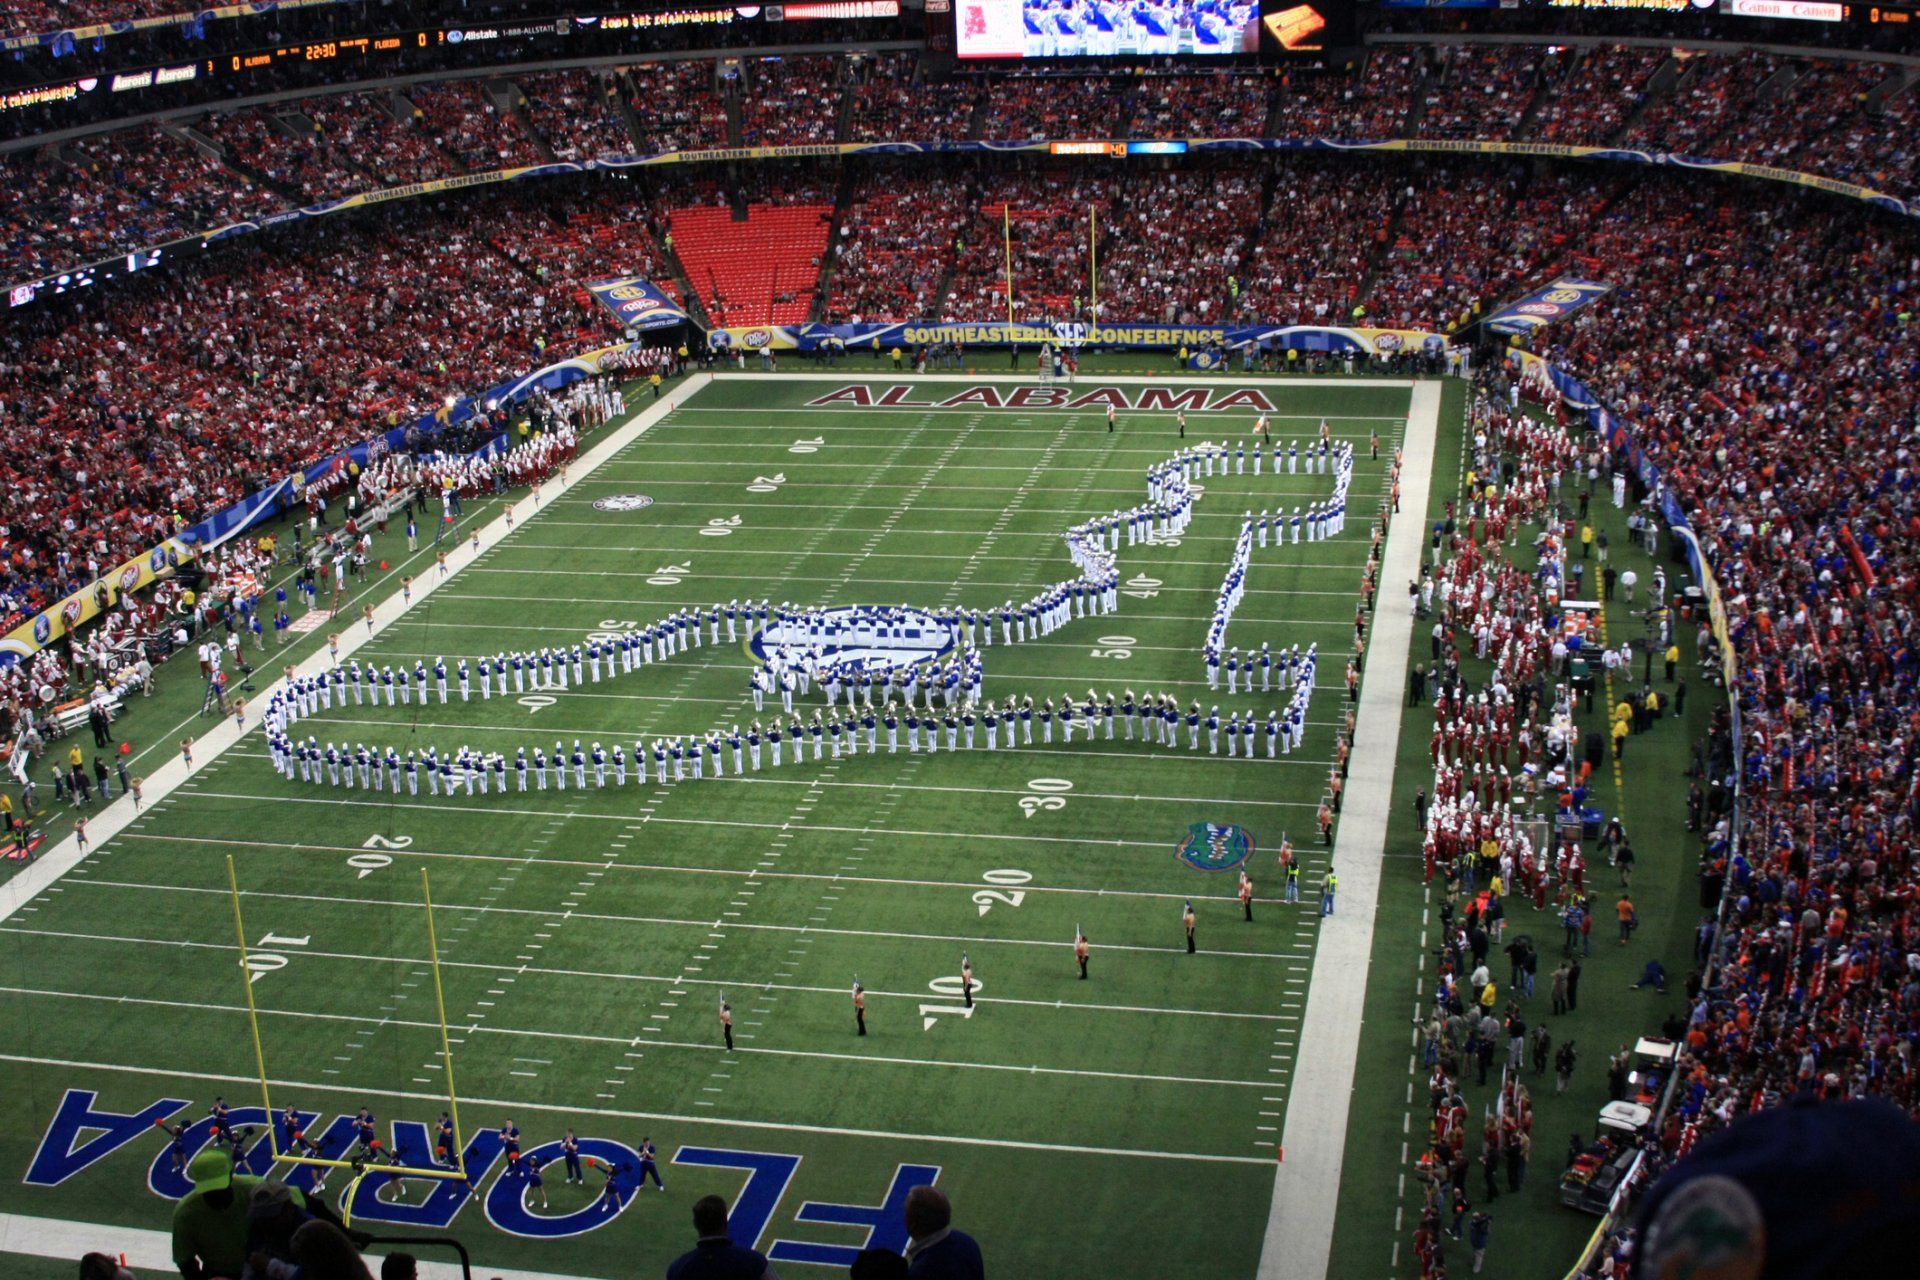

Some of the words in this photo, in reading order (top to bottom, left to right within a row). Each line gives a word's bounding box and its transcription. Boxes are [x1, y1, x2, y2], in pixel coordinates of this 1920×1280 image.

[1738, 2, 1780, 14] Canon
[1792, 6, 1836, 17] Canon
[463, 29, 498, 41] Allstate
[502, 25, 555, 36] 1-888-ALLSTATE
[600, 19, 629, 30] 2009
[306, 43, 336, 60] 22:30
[373, 39, 400, 50] FLORIDA
[418, 33, 426, 47] 0
[232, 56, 240, 71] 0
[112, 73, 152, 92] Aaron's
[155, 65, 196, 84] Aaron's
[678, 149, 751, 161] SOUTHEASTERN
[774, 146, 840, 157] CONFERENCE
[1056, 142, 1104, 154] HOOTERS
[1112, 144, 1126, 156] 40
[1406, 141, 1482, 150] SOUTHEASTERN
[1505, 143, 1573, 155] CONFERENCE
[1741, 164, 1800, 183] SOUTHEASTERN
[363, 184, 425, 203] SOUTHEASTERN
[444, 172, 505, 189] CONFERENCE
[903, 326, 1051, 345] SOUTHEASTERN
[1056, 322, 1086, 347] SEC
[805, 384, 1279, 413] ALABAMA
[788, 436, 825, 454] 10
[699, 514, 743, 536] 30
[1121, 577, 1163, 599] 40
[1089, 635, 1137, 660] 50
[1018, 778, 1074, 811] 30
[346, 834, 413, 869] 20
[972, 869, 1033, 908] 20
[238, 932, 311, 971] 10
[918, 976, 983, 1020] 10
[22, 1088, 942, 1267] FLORIDA
